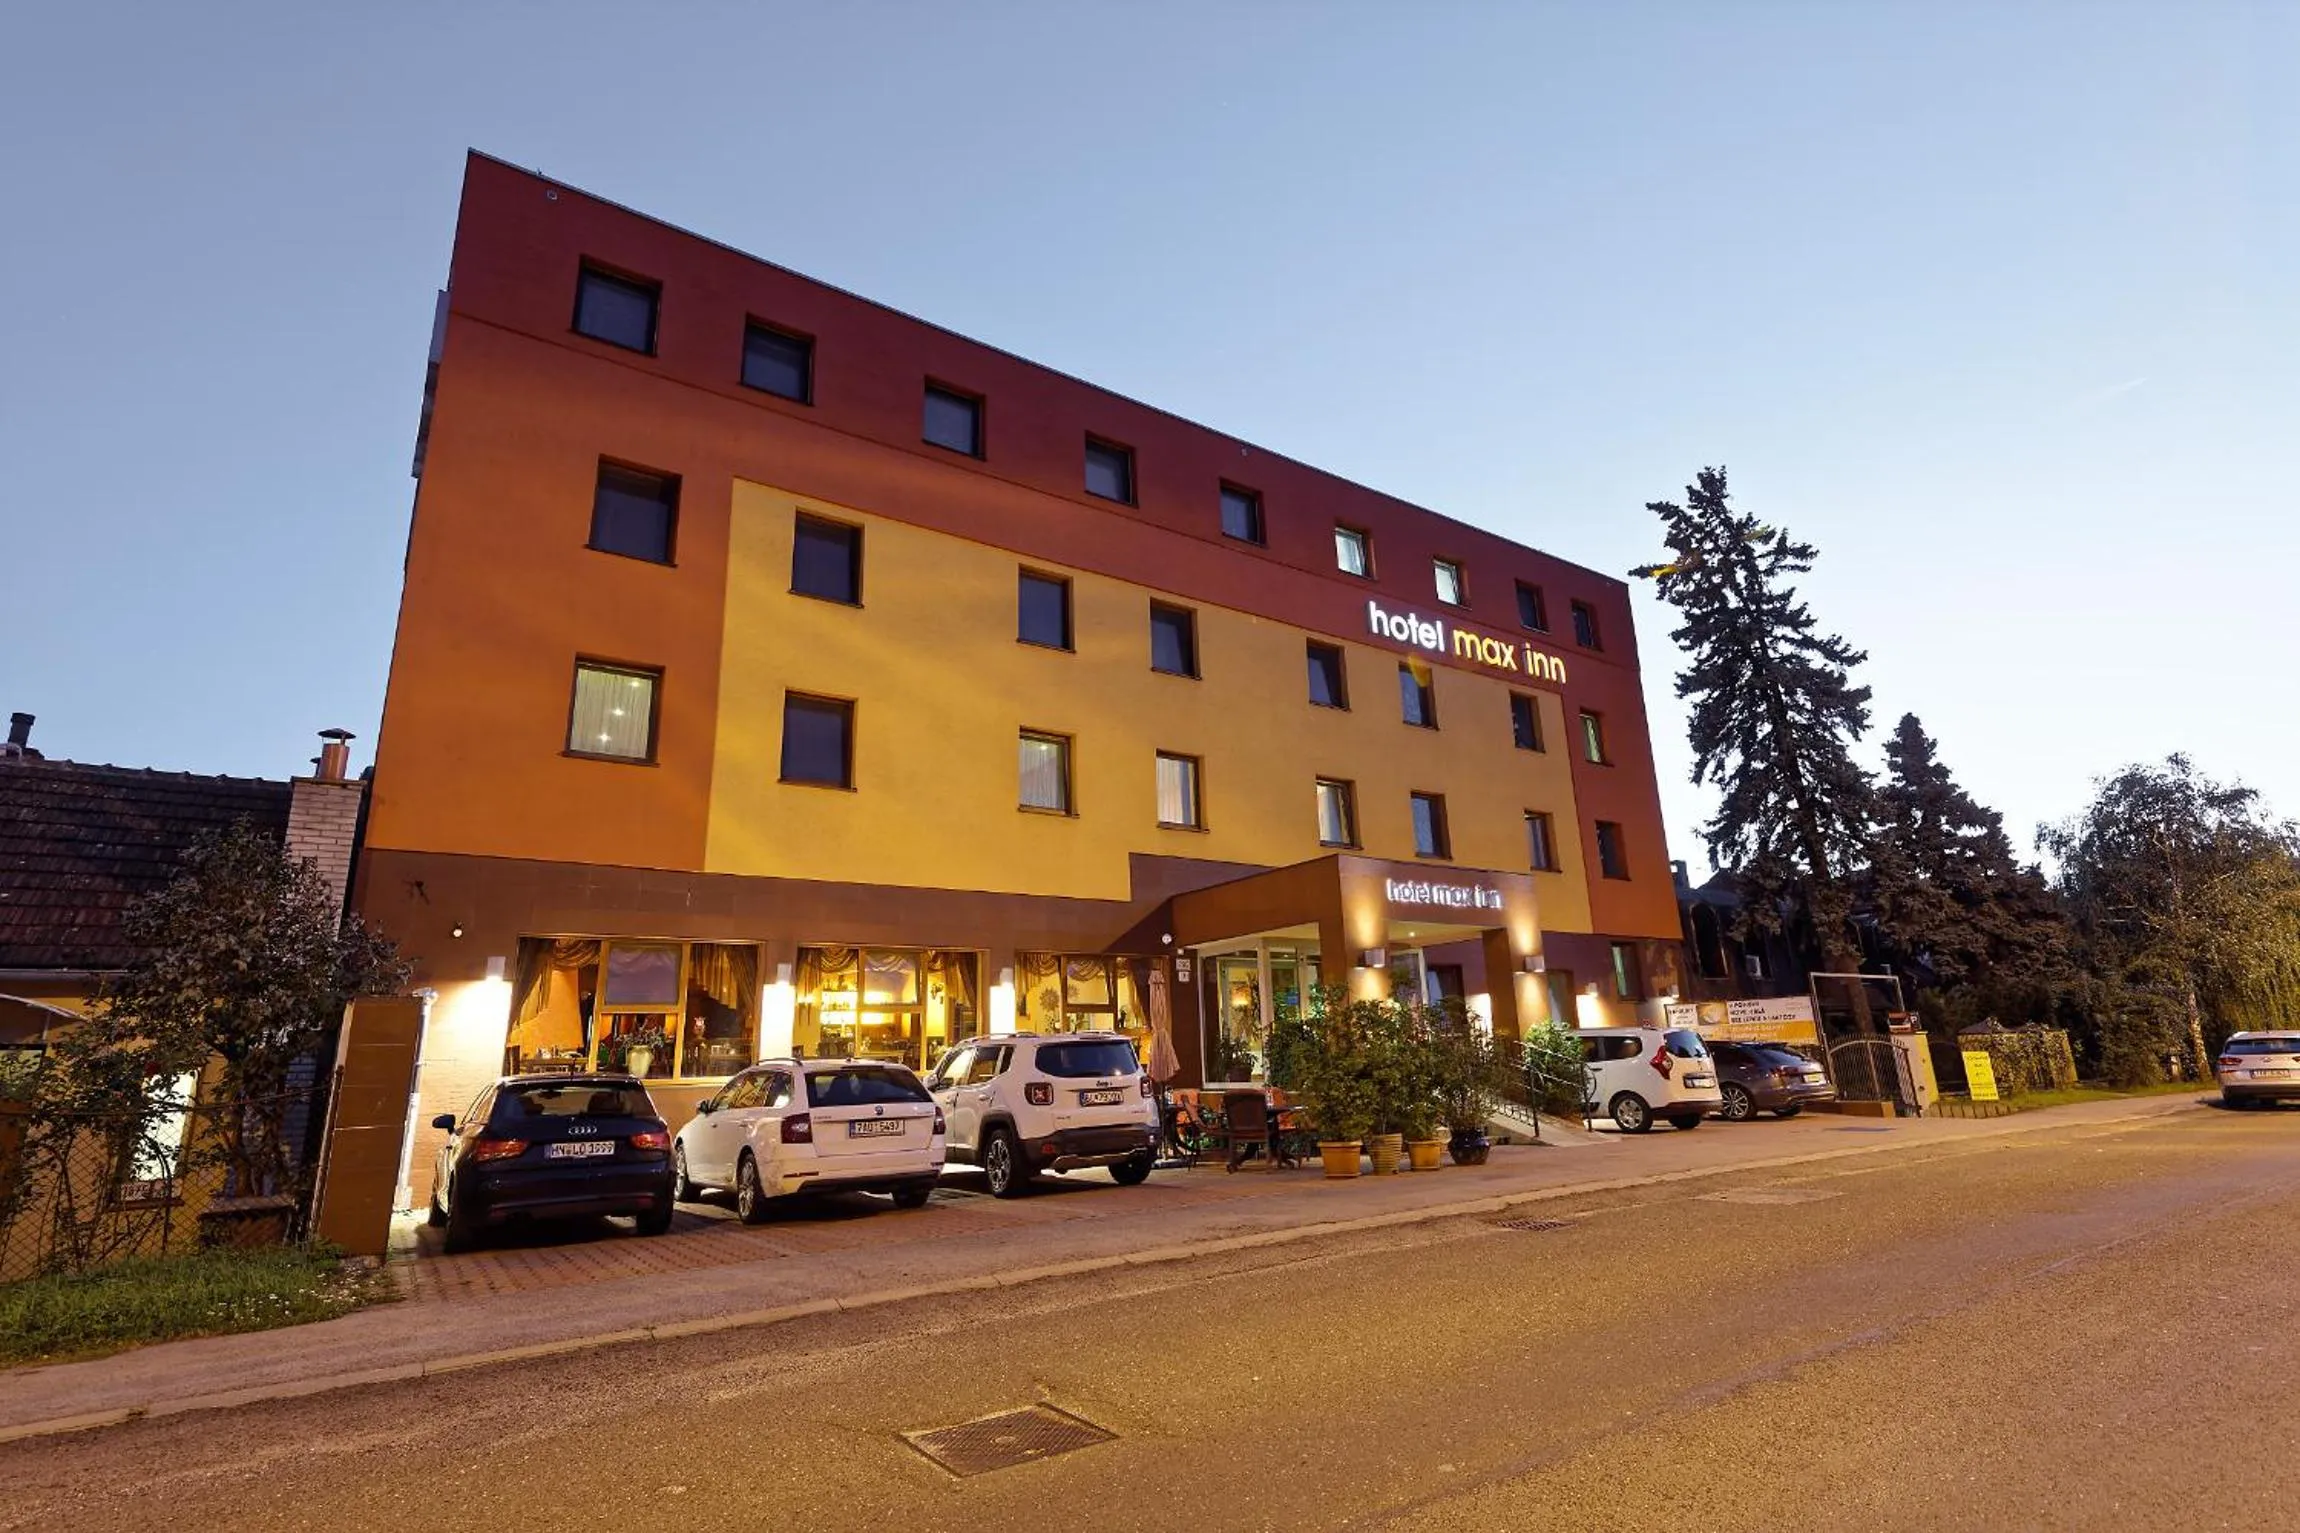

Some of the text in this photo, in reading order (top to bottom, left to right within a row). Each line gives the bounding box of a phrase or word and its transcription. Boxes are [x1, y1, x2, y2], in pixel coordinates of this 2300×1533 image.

[1368, 600, 1567, 684] hotel max inn
[1386, 878, 1430, 904] hotel
[1431, 884, 1473, 907] max
